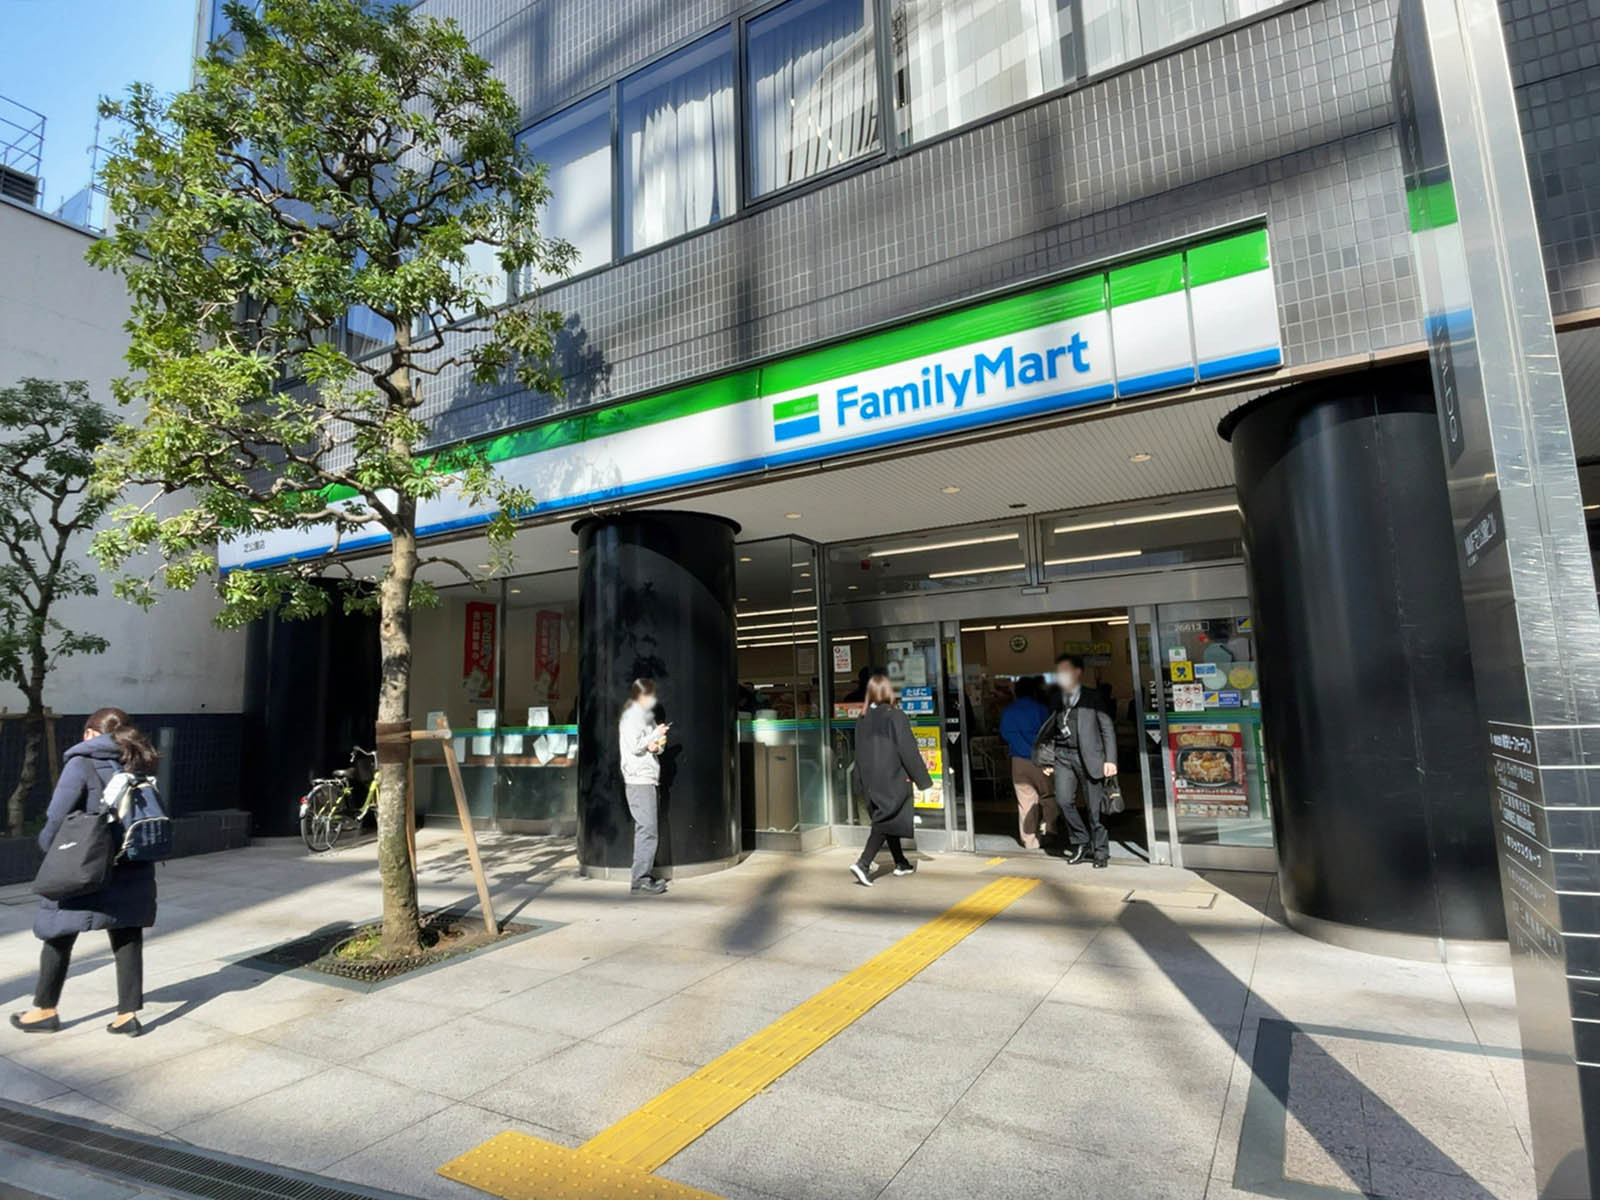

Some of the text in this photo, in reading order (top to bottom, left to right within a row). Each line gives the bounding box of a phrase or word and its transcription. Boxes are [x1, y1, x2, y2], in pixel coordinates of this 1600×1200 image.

[836, 332, 1090, 426] FamilyMart
[907, 688, 928, 697] たばこ
